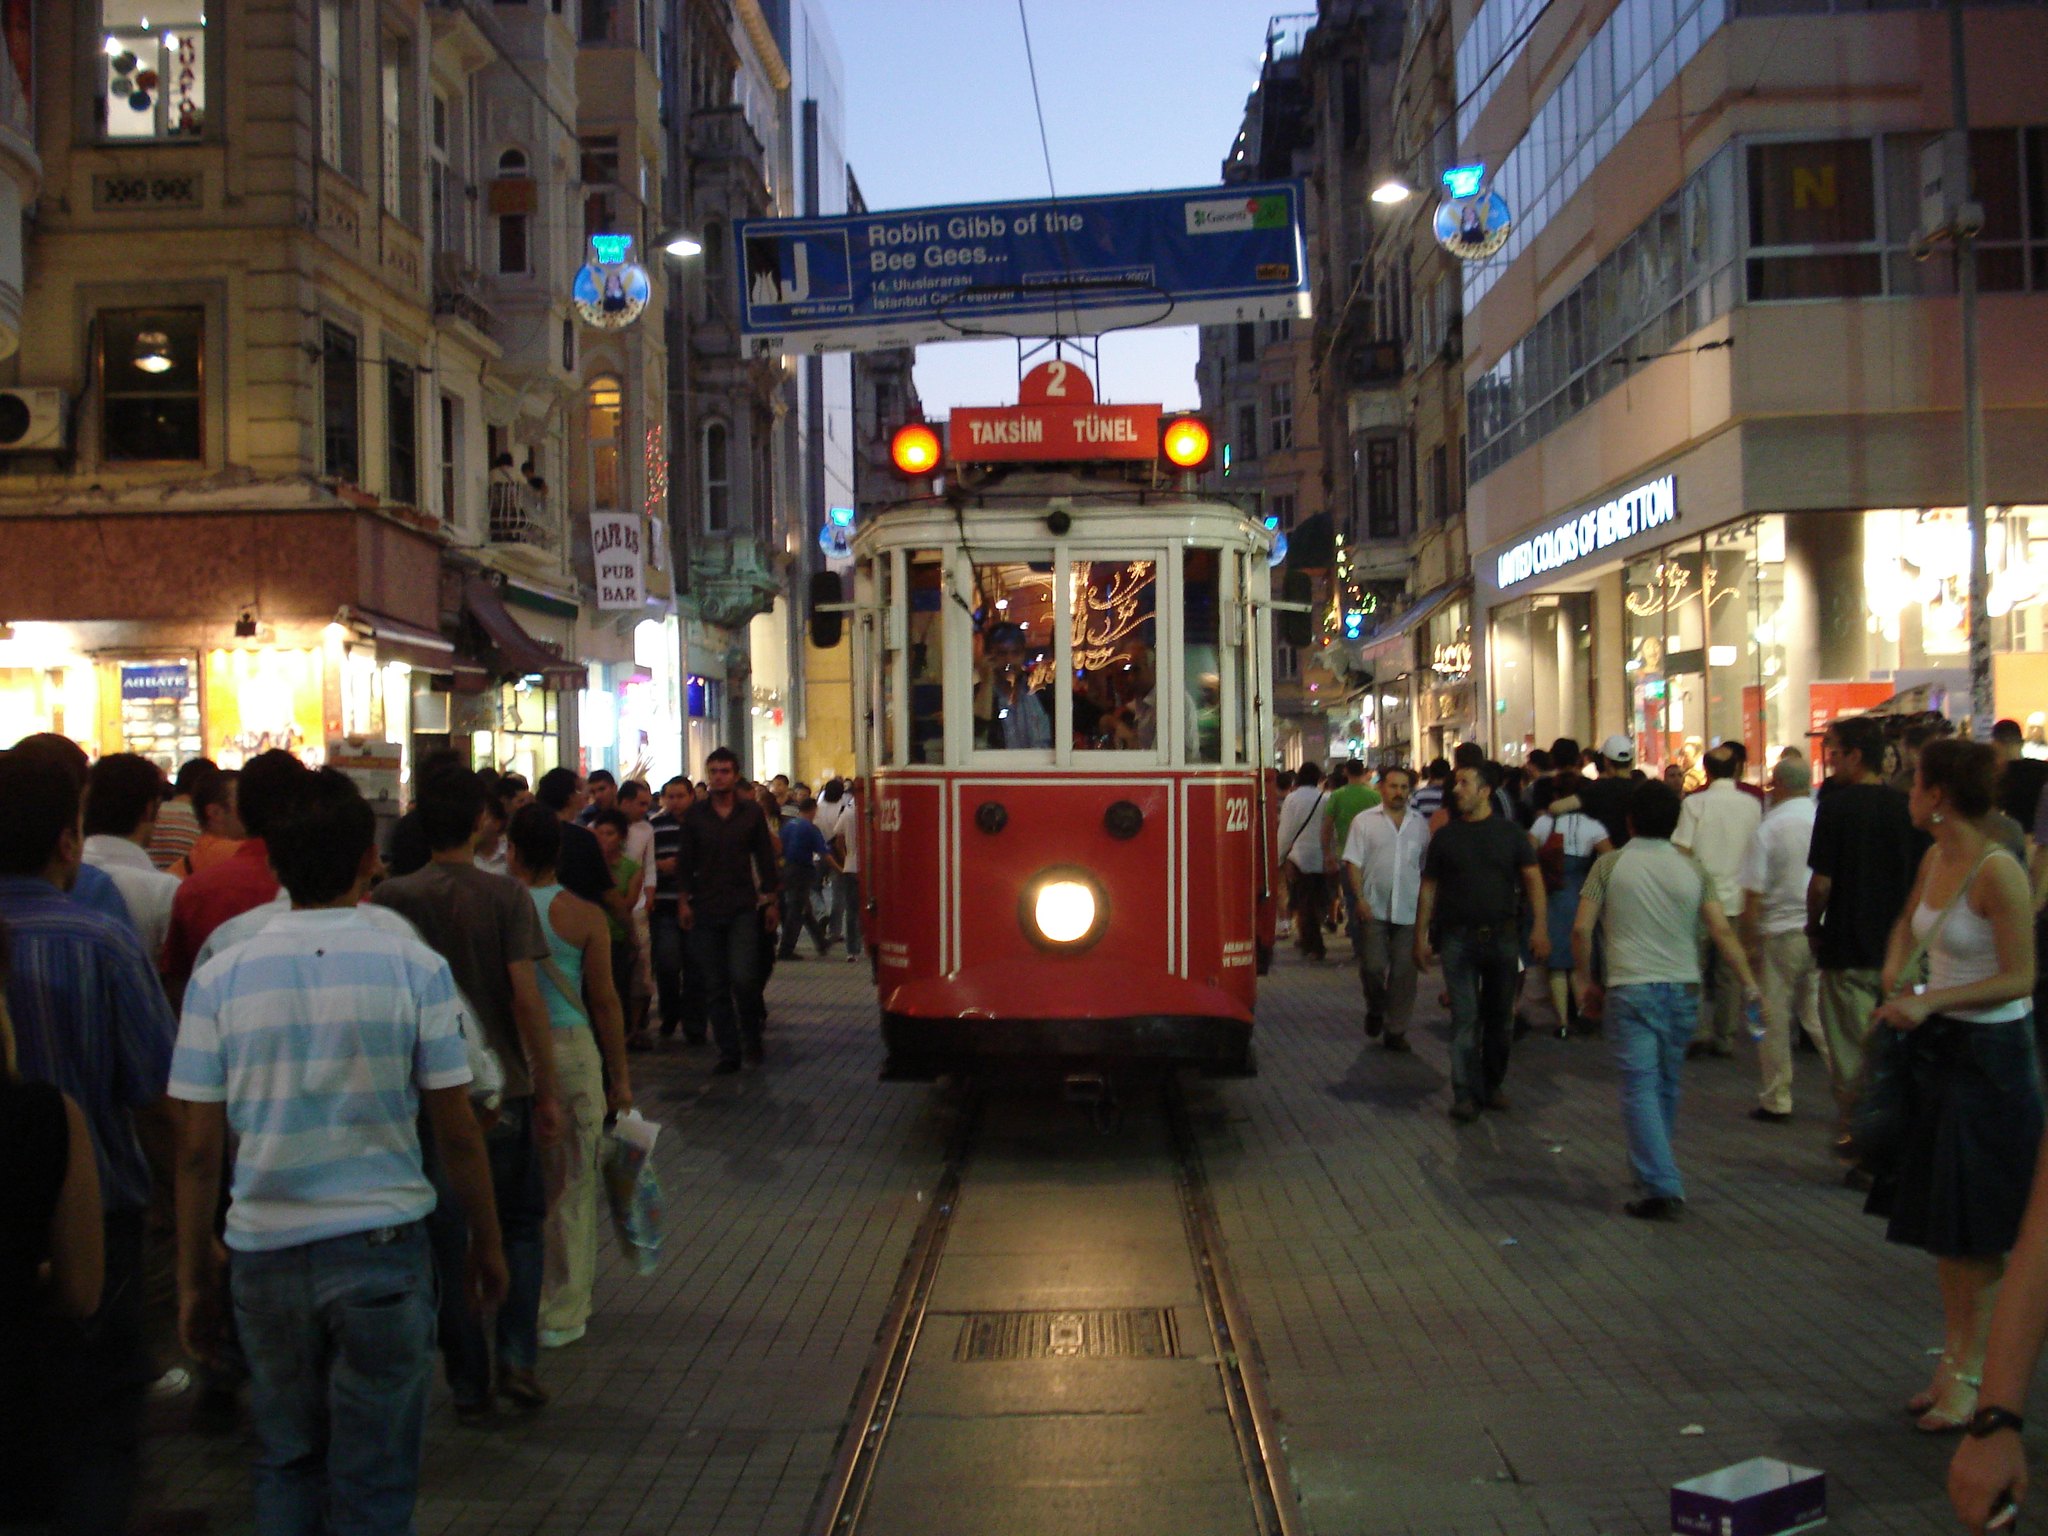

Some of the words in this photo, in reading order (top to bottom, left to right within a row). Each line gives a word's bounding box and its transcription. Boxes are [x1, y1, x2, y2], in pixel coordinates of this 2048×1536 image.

[867, 220, 941, 248] Robin
[947, 214, 1006, 240] Gibb
[1013, 213, 1037, 236] of
[1043, 211, 1084, 232] the
[780, 242, 810, 301] J
[869, 250, 917, 273] Bee
[924, 245, 1009, 268] Gees...
[871, 280, 889, 293] 14.
[1045, 360, 1067, 397] 2
[969, 415, 1043, 445] TAKSİM
[1072, 413, 1138, 443] TÜNEL
[1532, 519, 1579, 575] COLORS
[1578, 510, 1599, 557] OF
[1597, 474, 1677, 549] BENETTON
[602, 565, 634, 579] PUB
[603, 586, 638, 601] BAR
[1225, 797, 1250, 833] 223
